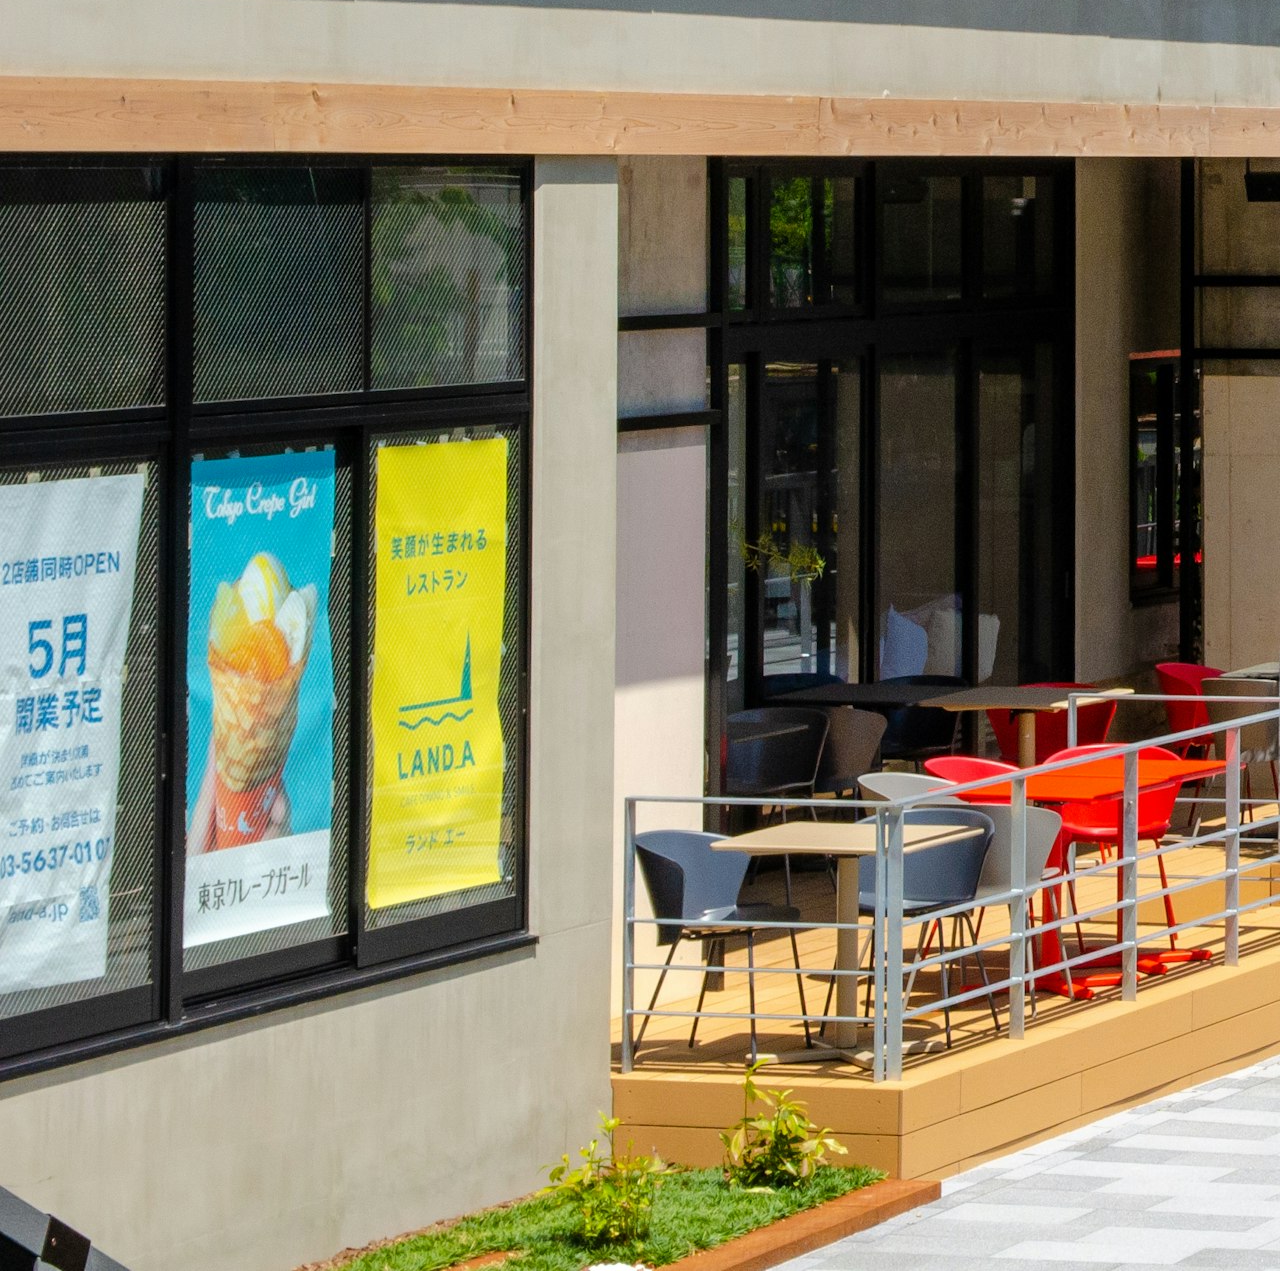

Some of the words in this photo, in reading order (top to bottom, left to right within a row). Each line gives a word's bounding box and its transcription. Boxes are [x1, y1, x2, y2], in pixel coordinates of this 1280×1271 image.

[246, 481, 285, 521] Crepe
[289, 476, 317, 519] Girl
[391, 529, 487, 561] 笑顔が生まれる
[2, 551, 120, 586] 2店舗同時OPEN
[406, 569, 468, 596] レストラン
[28, 613, 88, 680] 5月
[16, 687, 103, 735] 開業予定
[197, 862, 313, 914] 東京クレープガール
